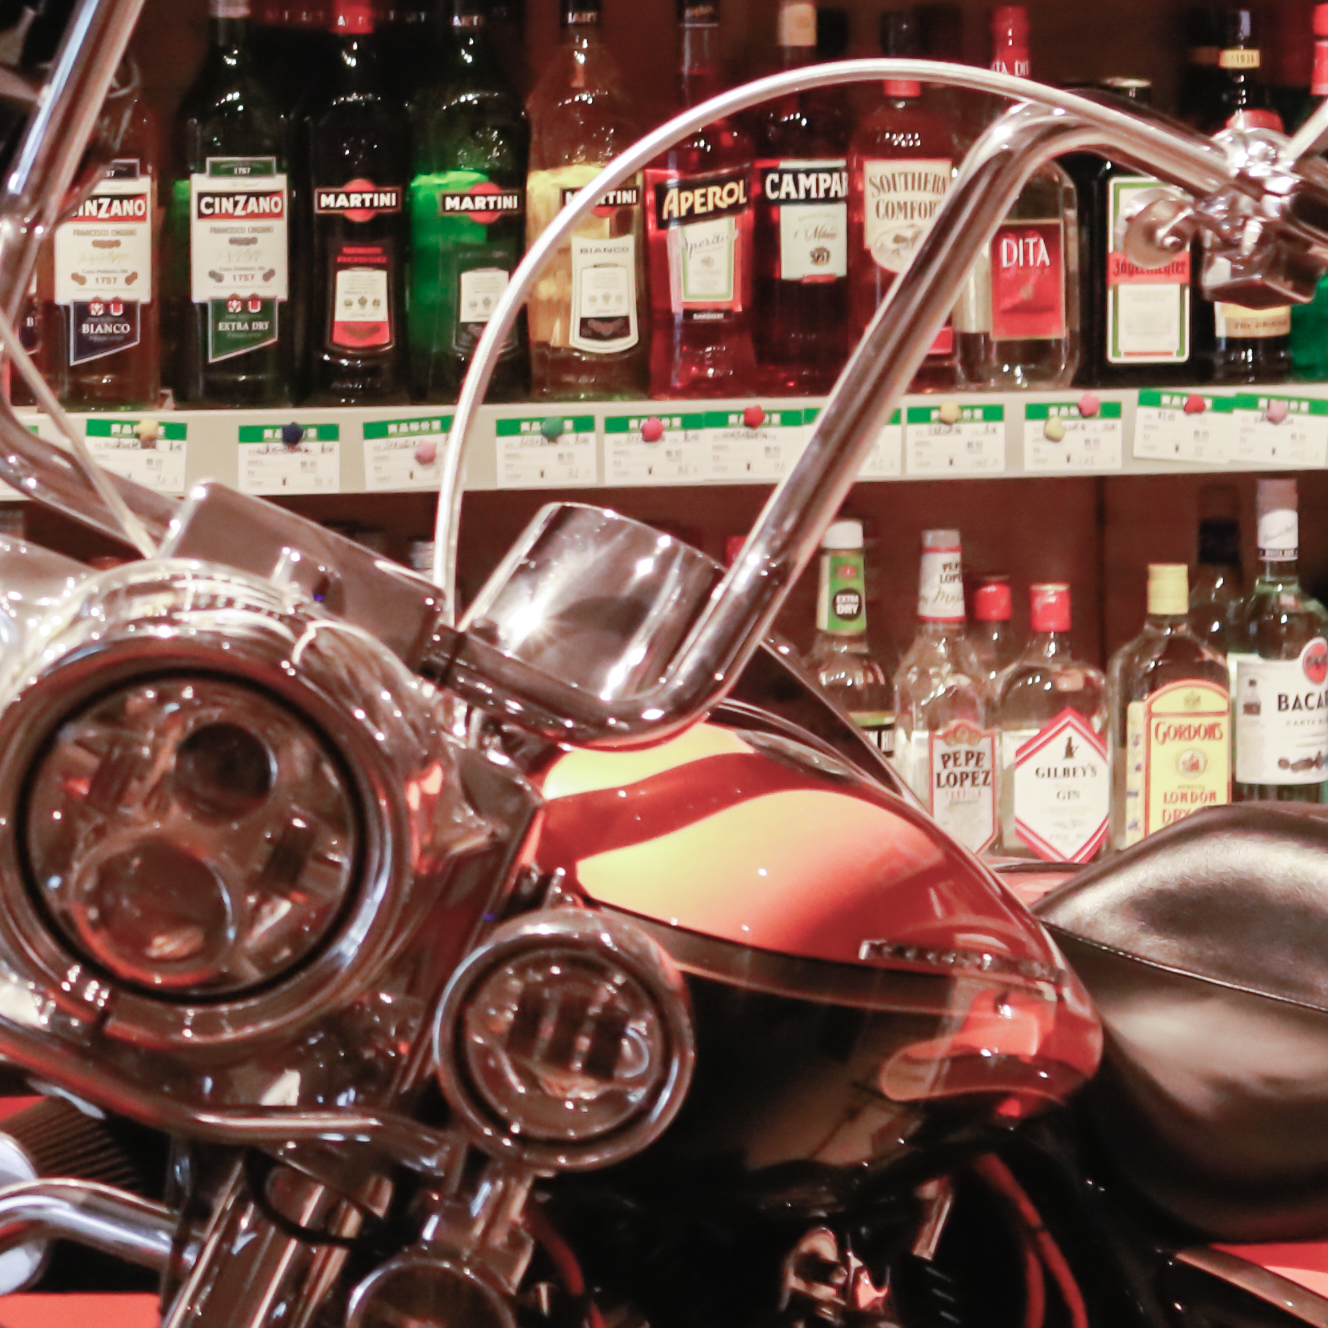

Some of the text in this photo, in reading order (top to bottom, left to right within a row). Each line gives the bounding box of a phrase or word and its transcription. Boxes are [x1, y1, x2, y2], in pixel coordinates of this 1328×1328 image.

[199, 192, 282, 215] CINZANO
[320, 193, 397, 209] MARTINI
[445, 195, 518, 211] MARTINI
[663, 179, 746, 218] APEROL
[1003, 239, 1051, 269] DITA
[82, 323, 130, 333] BIANCO
[218, 320, 270, 332] EXTRA DRY
[941, 750, 985, 769] PEPE
[936, 770, 992, 788] LOPEZ
[1035, 764, 1097, 779] GILBEY'S
[1056, 791, 1081, 801] GIN
[1163, 792, 1218, 805] LONDON
